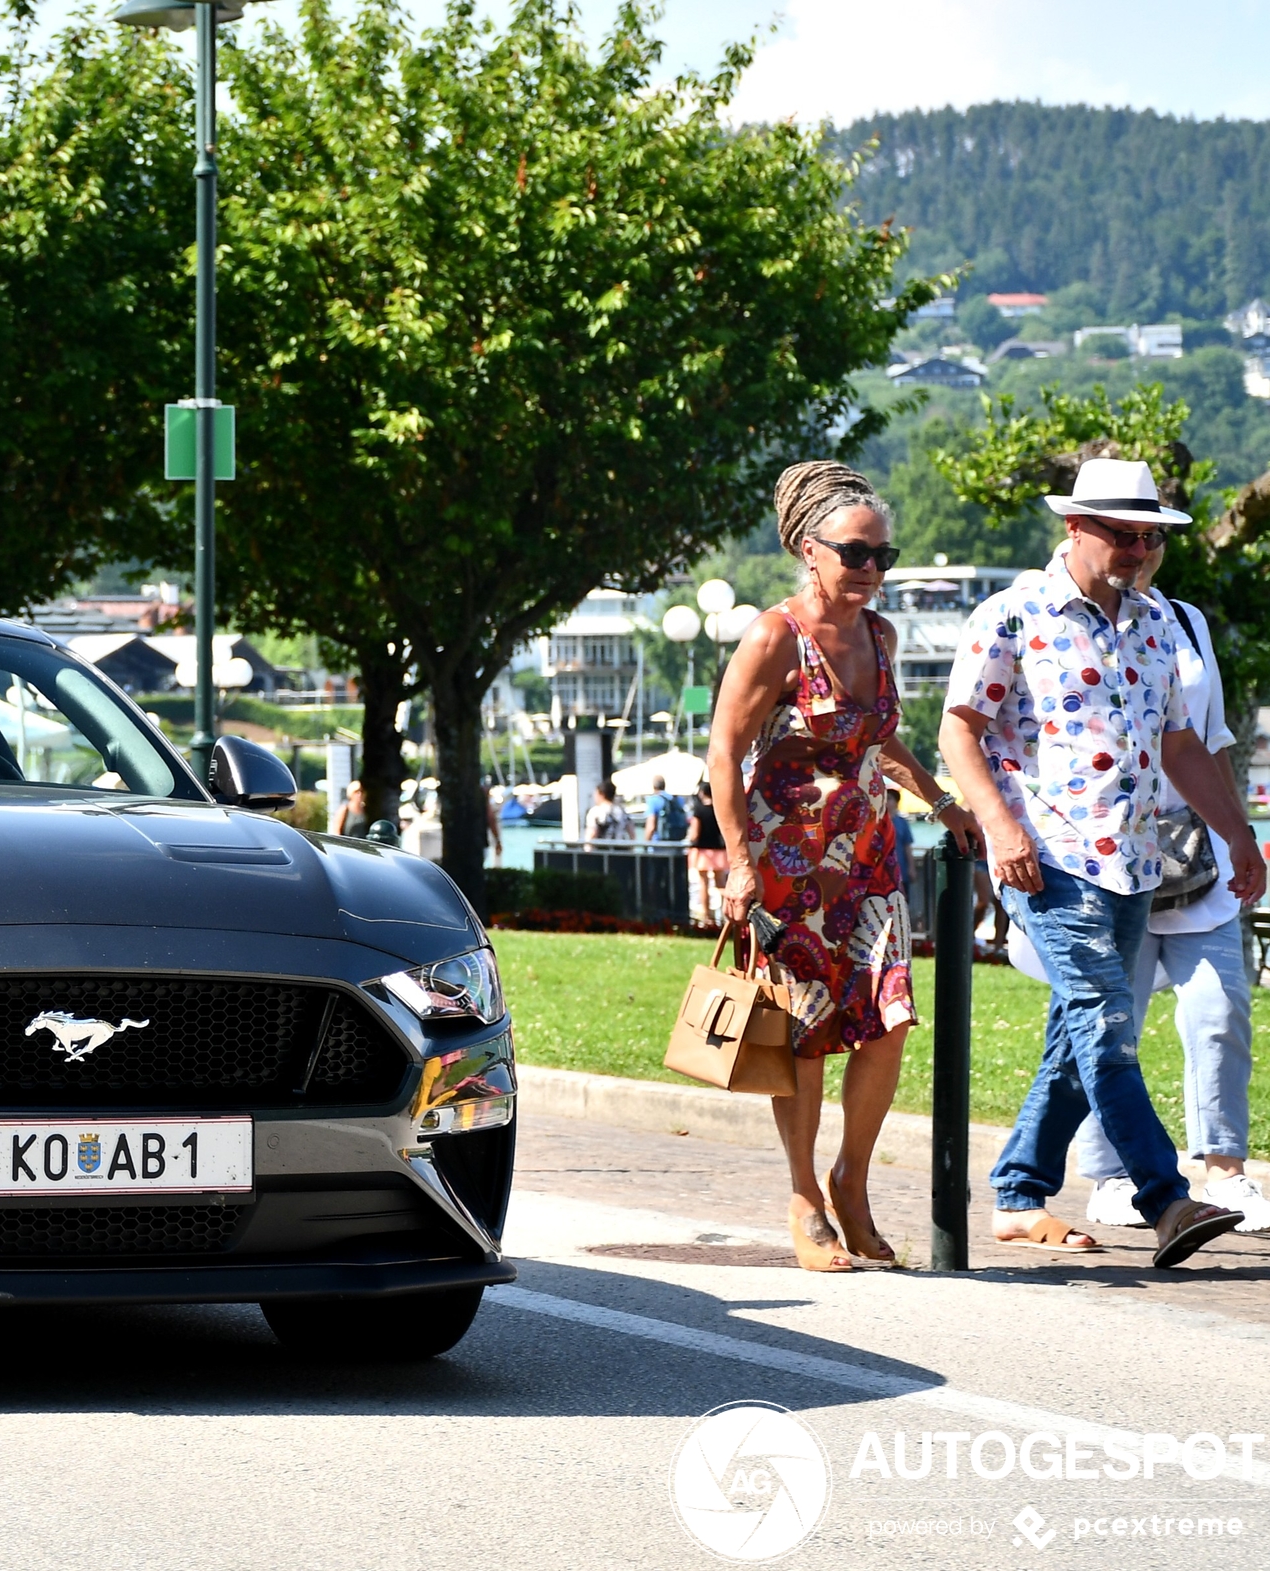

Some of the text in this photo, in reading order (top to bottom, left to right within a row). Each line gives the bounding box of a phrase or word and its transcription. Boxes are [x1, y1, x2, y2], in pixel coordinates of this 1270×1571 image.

[12, 1131, 198, 1182] KO AB 1
